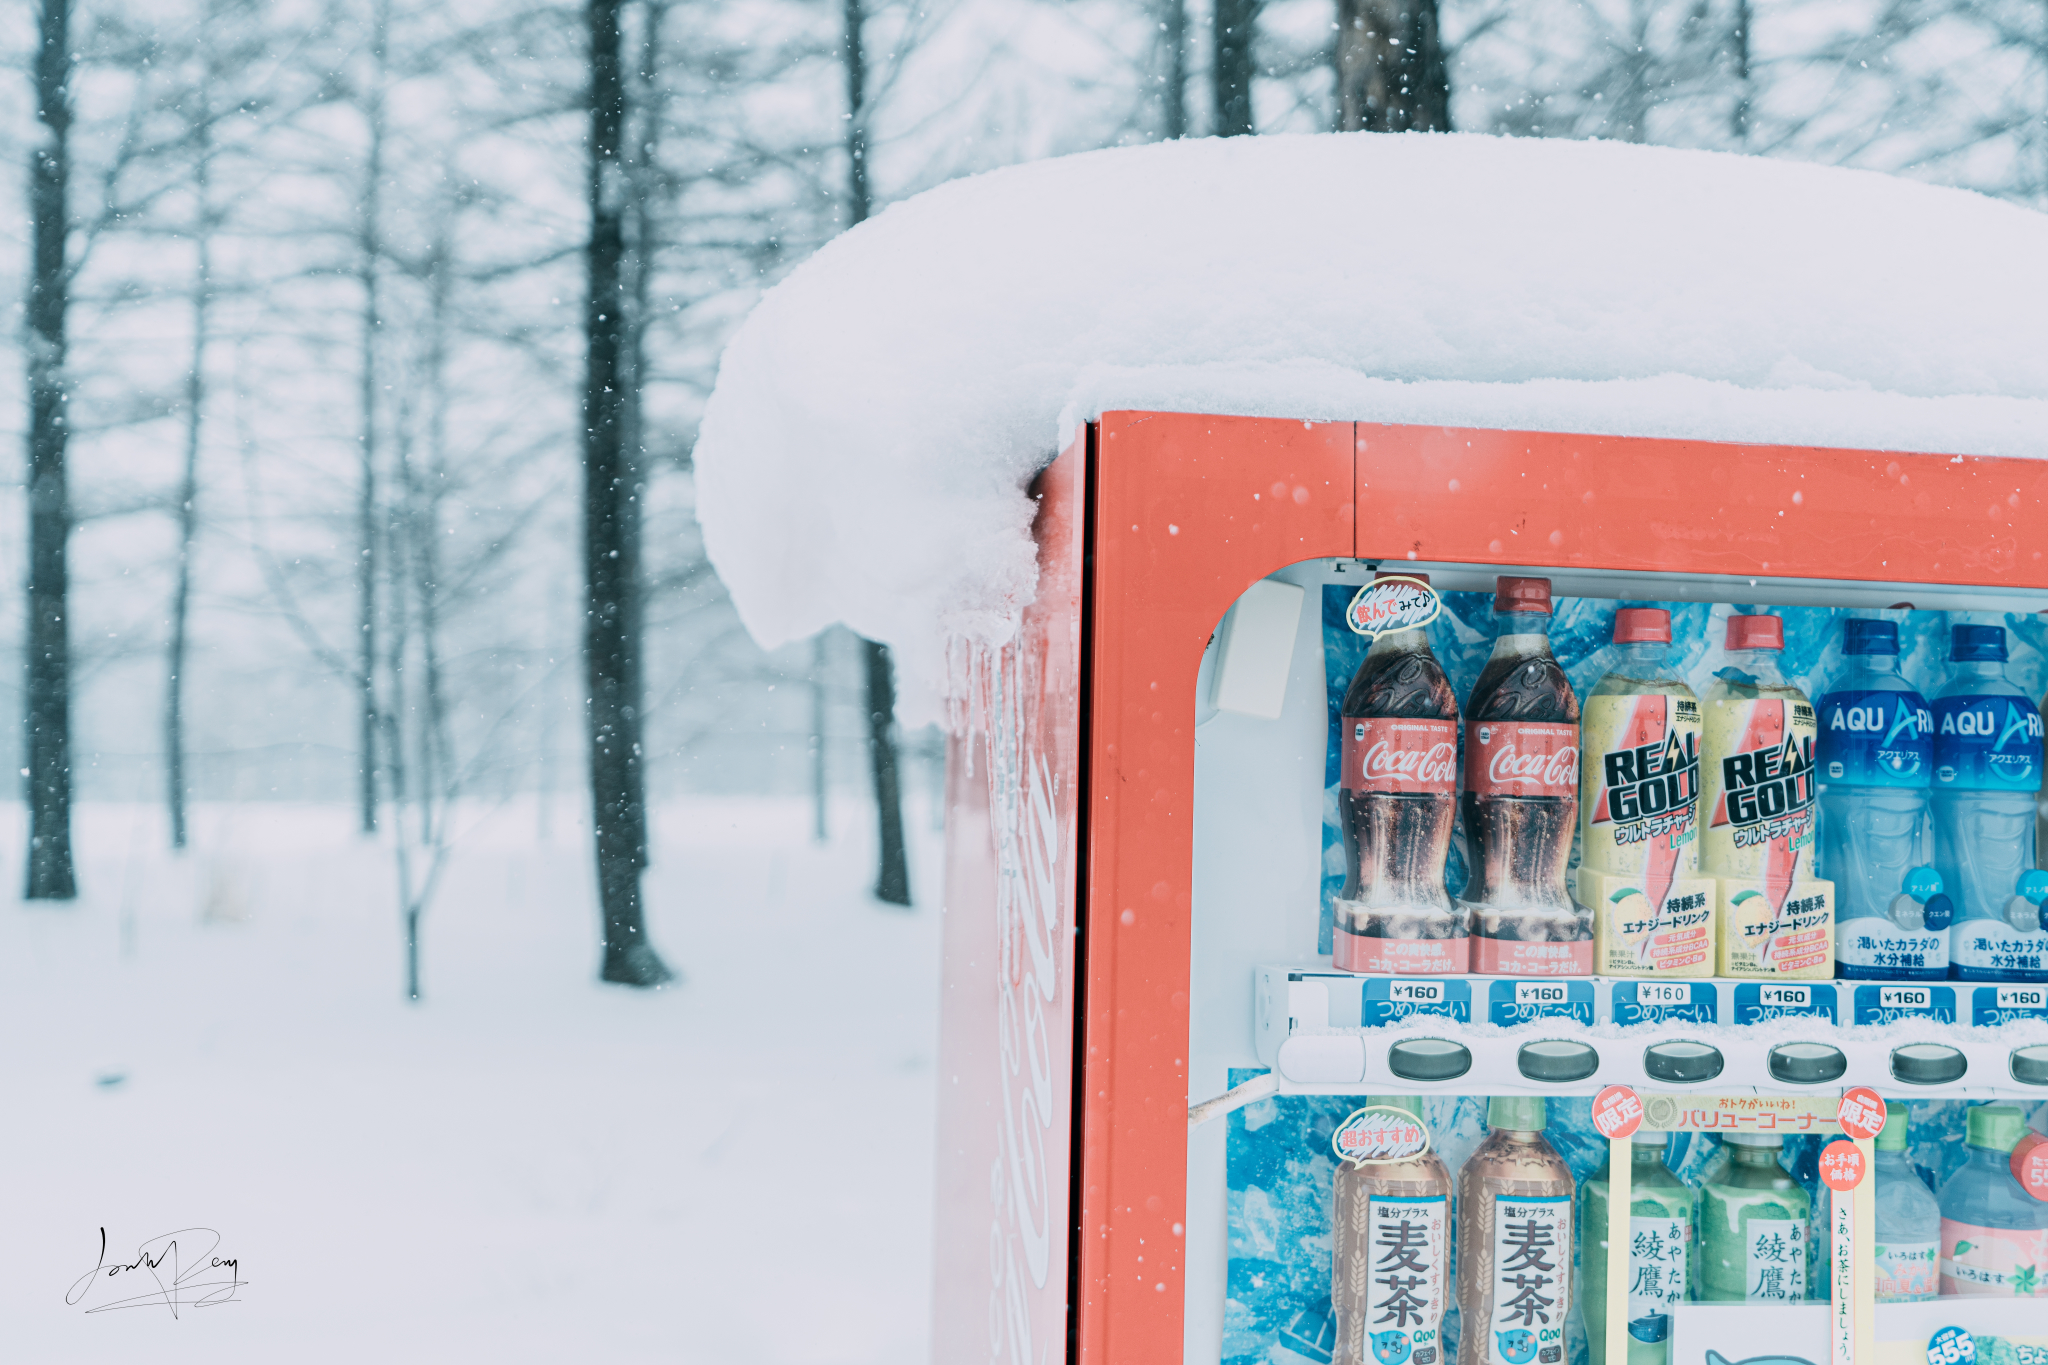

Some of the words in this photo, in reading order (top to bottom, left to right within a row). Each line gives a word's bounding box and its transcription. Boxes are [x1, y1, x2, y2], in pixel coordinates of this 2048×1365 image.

[1390, 724, 1428, 732] ORIGINAL
[1430, 725, 1448, 733] TASTE
[1831, 697, 1935, 748] AQUARI
[1517, 728, 1554, 736] ORIGINAL
[1556, 729, 1572, 737] TASTE
[1603, 726, 1699, 787] REAL
[1722, 729, 1814, 791] REAL
[1878, 750, 1919, 760] アクエリアス
[1990, 754, 2032, 764] アクエリアス
[1608, 762, 1699, 824] GOLD
[1614, 805, 1696, 845] ウルトラチャージ
[1733, 808, 1813, 849] ウルトラチャージ
[1670, 827, 1697, 850] Lemon
[1667, 892, 1706, 914] 持続系
[1787, 894, 1825, 916] 持続系
[1623, 910, 1710, 933] エナジードリンク
[1745, 912, 1829, 936] エナジードリンク
[1668, 930, 1697, 942] 元気成分
[1857, 936, 1939, 951] 渇いたカラダの
[1609, 950, 1634, 958] 無果汁
[1731, 952, 1756, 960] 無果汁
[1874, 952, 1924, 967] 水分補給
[1991, 954, 2041, 969] 水分補給
[1369, 959, 1456, 972] コカ・コーラだけ。
[1499, 961, 1582, 974] コカ・コーラだけ。
[1394, 986, 1438, 999] ¥160
[1521, 988, 1563, 1000] ¥160
[1642, 986, 1684, 1000] ¥160
[1764, 990, 1805, 1003] ¥160
[1884, 992, 1925, 1004] ¥160
[2001, 992, 2041, 1004] ¥160
[1596, 1096, 1642, 1135] 限定
[1678, 1110, 1837, 1129] バリューコーナー
[1839, 1098, 1883, 1135] 限定
[1342, 1126, 1419, 1149] 超おすすめ
[1824, 1153, 1859, 1167] お手頃
[1830, 1168, 1857, 1181] 価格
[1377, 1206, 1429, 1218] 塩分プラス
[1504, 1206, 1555, 1218] 塩分プラス
[1888, 1251, 1925, 1260] いろはす
[1430, 1218, 1441, 1324] おいしくすっきり
[1556, 1218, 1566, 1323] おいしくすっきり
[1629, 1230, 1666, 1298] 綾鷹
[1667, 1222, 1682, 1306] あやたか
[1751, 1232, 1788, 1299] 綾鷹
[1789, 1223, 1802, 1305] あやたか
[1894, 1263, 1929, 1275] みかん
[1373, 1220, 1430, 1327] 麦茶
[1500, 1220, 1555, 1326] 麦茶
[1955, 1267, 2005, 1284] いろはす
[1837, 1207, 1850, 1361] さあ、お茶にしましょう。
[1413, 1329, 1436, 1343] Qoo
[1539, 1328, 1561, 1342] Qoo
[1415, 1349, 1435, 1358] カフェイン
